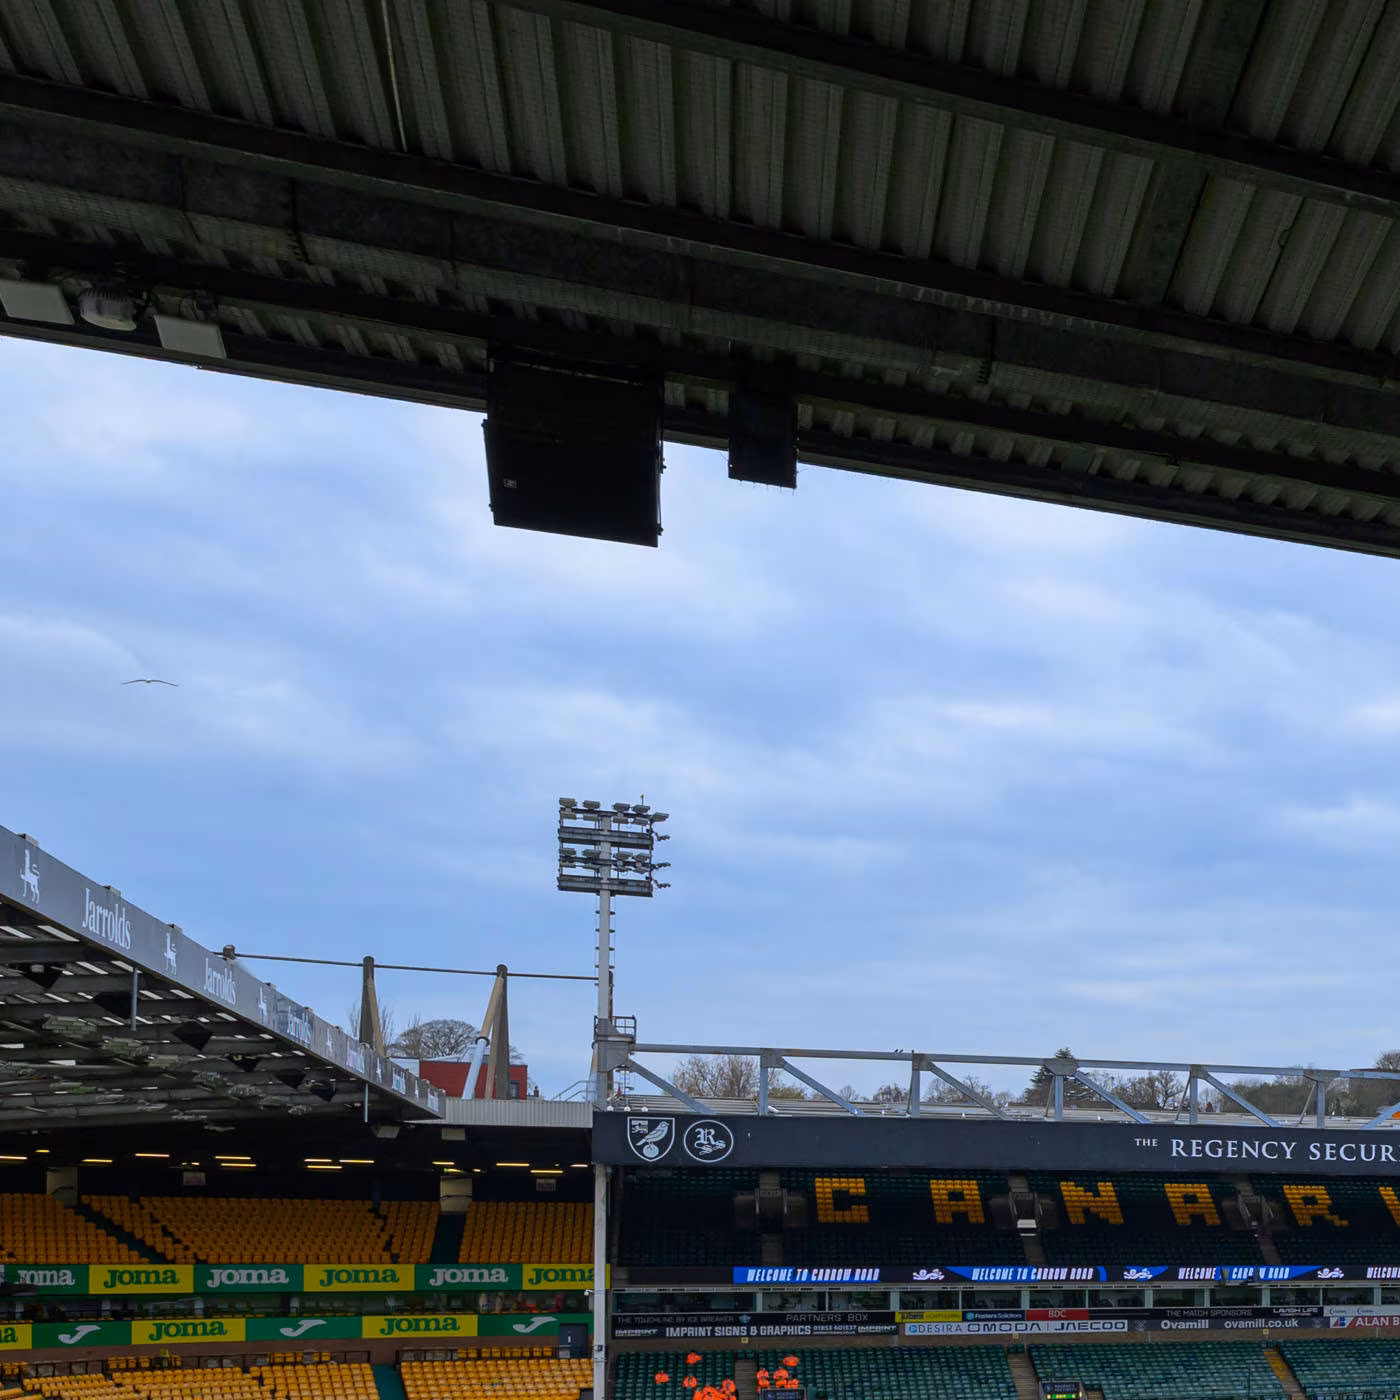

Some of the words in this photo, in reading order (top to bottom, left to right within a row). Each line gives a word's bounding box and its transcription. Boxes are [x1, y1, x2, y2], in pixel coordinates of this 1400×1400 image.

[81, 887, 131, 951] Jarrolds
[204, 957, 237, 1006] Jarrolds
[1134, 1138, 1158, 1147] THE
[1171, 1138, 1297, 1160] REGENCY
[104, 1269, 179, 1288] Joma
[207, 1268, 289, 1288] Joma
[320, 1269, 399, 1287] Joma
[429, 1268, 508, 1286] Joma
[747, 1269, 793, 1282] WELCOME
[796, 1269, 808, 1281] TO
[811, 1268, 851, 1281] CARROW
[854, 1268, 880, 1280] ROAD
[971, 1268, 1016, 1280] WELCOME
[1018, 1268, 1028, 1280] TO
[1030, 1268, 1068, 1280] CARROW
[1070, 1267, 1093, 1279] ROAD
[1178, 1268, 1216, 1280] WELCOME
[1232, 1267, 1266, 1279] CARRW
[1268, 1267, 1290, 1279] ROAD
[1367, 1267, 1400, 1278] WELCOME
[848, 1313, 869, 1321] BOX
[1048, 1310, 1066, 1319] BDC
[380, 1316, 460, 1336] Joma
[919, 1323, 962, 1333] DESIRA
[967, 1323, 1041, 1332] OMODA
[1054, 1321, 1125, 1331] JAECOO
[1161, 1320, 1209, 1329] Ovamill
[1224, 1318, 1299, 1329] ovamill.co.uk
[1356, 1317, 1389, 1326] ALAN
[149, 1321, 227, 1341] Joma
[666, 1326, 712, 1337] IMPRINT
[714, 1325, 748, 1336] SIGNS
[760, 1325, 811, 1336] GRAPHICS
